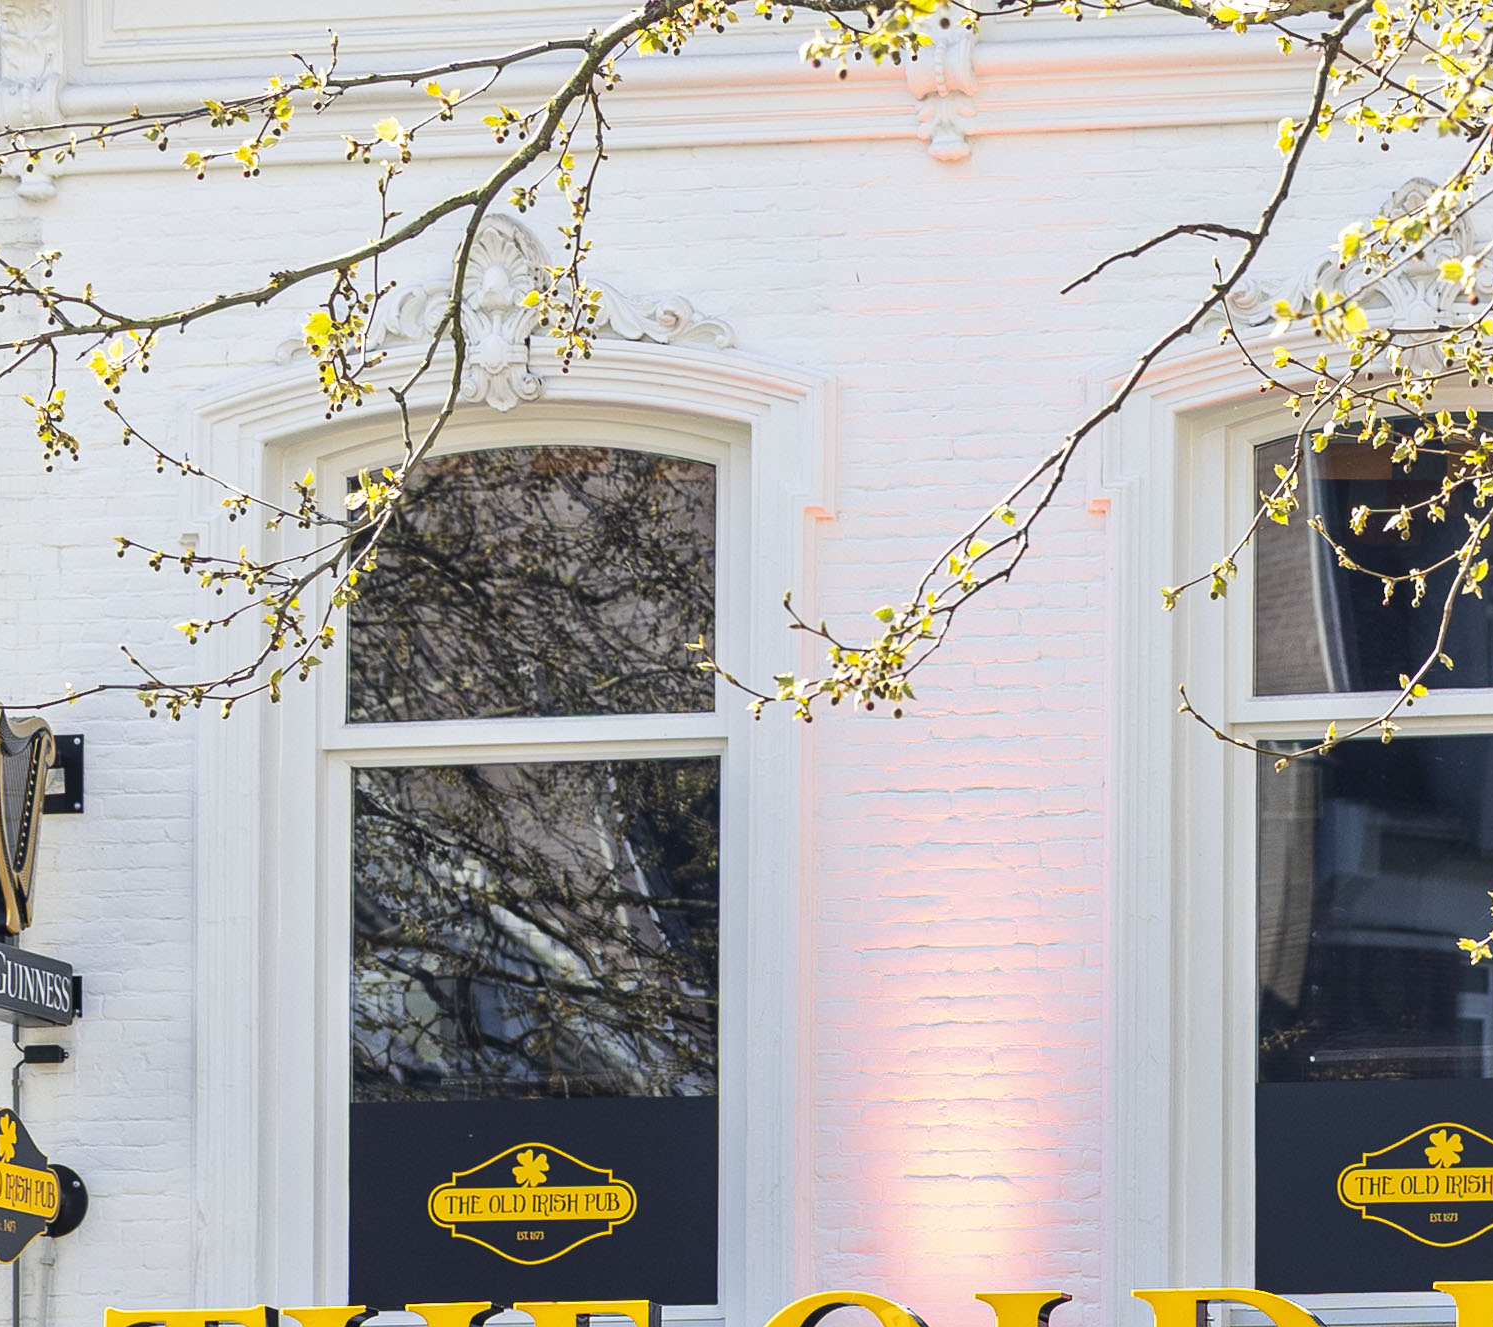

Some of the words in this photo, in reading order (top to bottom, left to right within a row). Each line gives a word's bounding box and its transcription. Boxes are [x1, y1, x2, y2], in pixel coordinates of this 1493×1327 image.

[5, 1172, 33, 1208] IRISH
[34, 1179, 56, 1209] PUB
[1355, 1175, 1396, 1198] THE
[1400, 1174, 1439, 1195] OLD
[1445, 1173, 1493, 1198] IRISH
[444, 1194, 483, 1217] THE
[488, 1194, 526, 1214] OLD
[532, 1192, 579, 1217] IRISH
[585, 1192, 620, 1212] PUB
